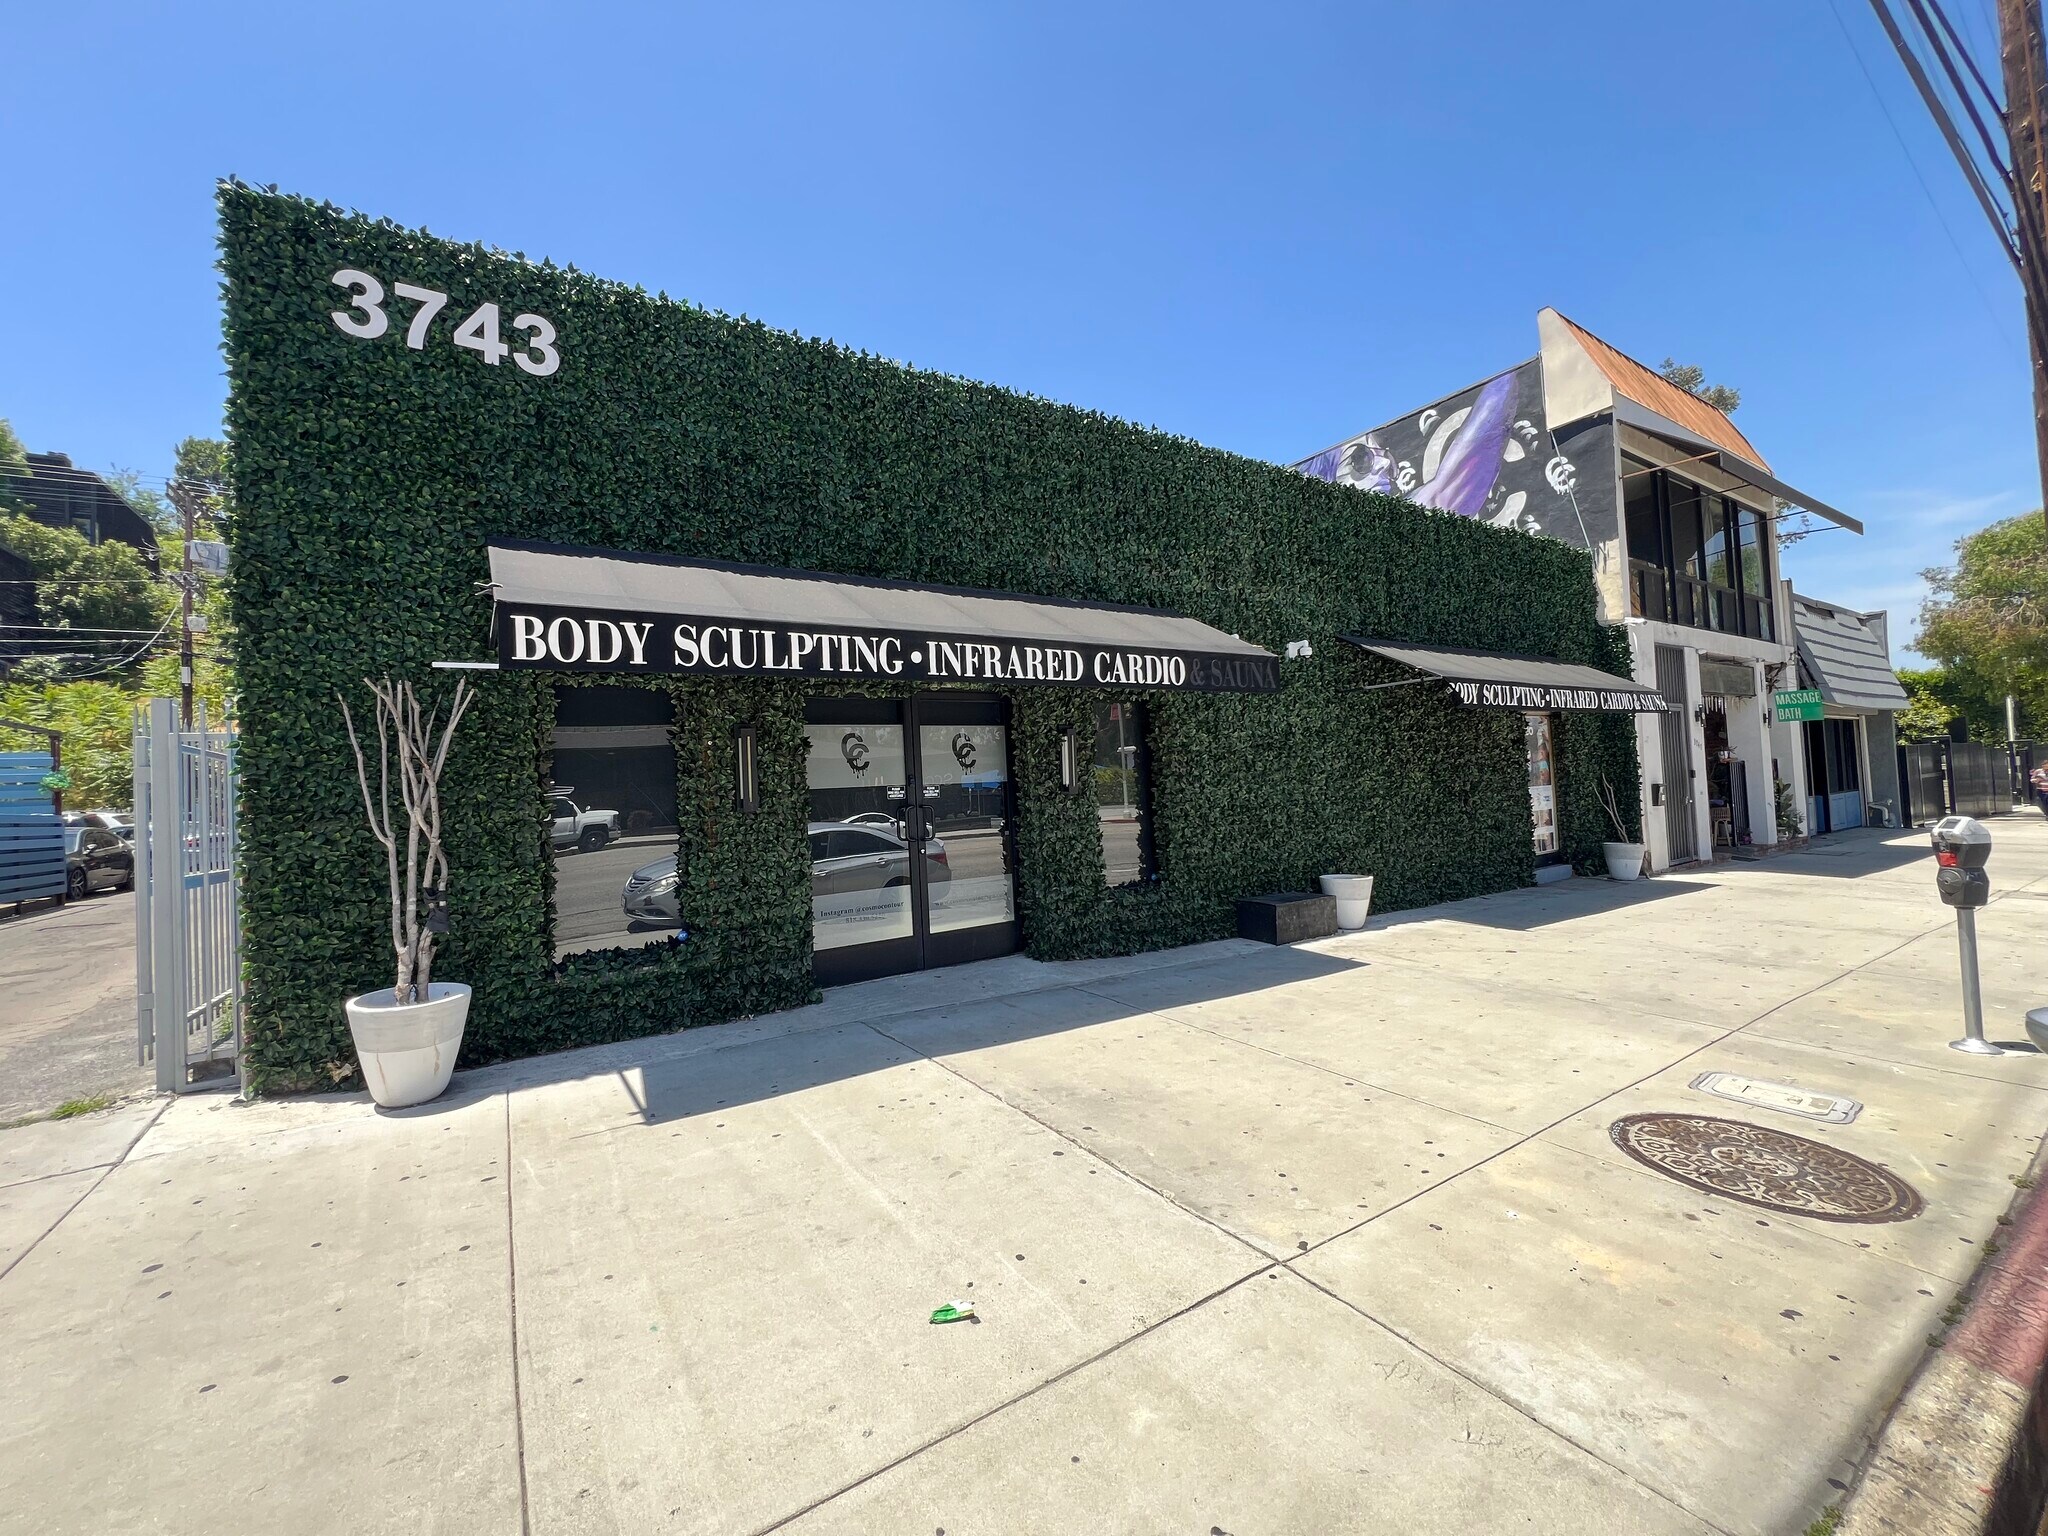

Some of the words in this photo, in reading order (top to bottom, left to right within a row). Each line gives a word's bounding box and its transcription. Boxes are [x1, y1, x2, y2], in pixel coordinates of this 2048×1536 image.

[331, 269, 560, 377] 3743
[510, 614, 654, 665] BODY
[674, 624, 904, 675] SCULPTING
[925, 640, 1085, 682] INFRARED
[1093, 651, 1186, 687] CARDIO
[1189, 658, 1206, 687] &
[1210, 659, 1277, 689] SAUNA
[1449, 682, 1480, 705] ODY
[1482, 683, 1546, 708] SCULPTING
[1549, 688, 1599, 710] INFRARED
[1600, 691, 1633, 711] CARDIO
[1633, 694, 1641, 710] &
[1640, 693, 1668, 711] SAUNA
[1775, 691, 1822, 706] MASSAGE
[1778, 707, 1802, 720] BATH
[820, 908, 854, 917] Instagram
